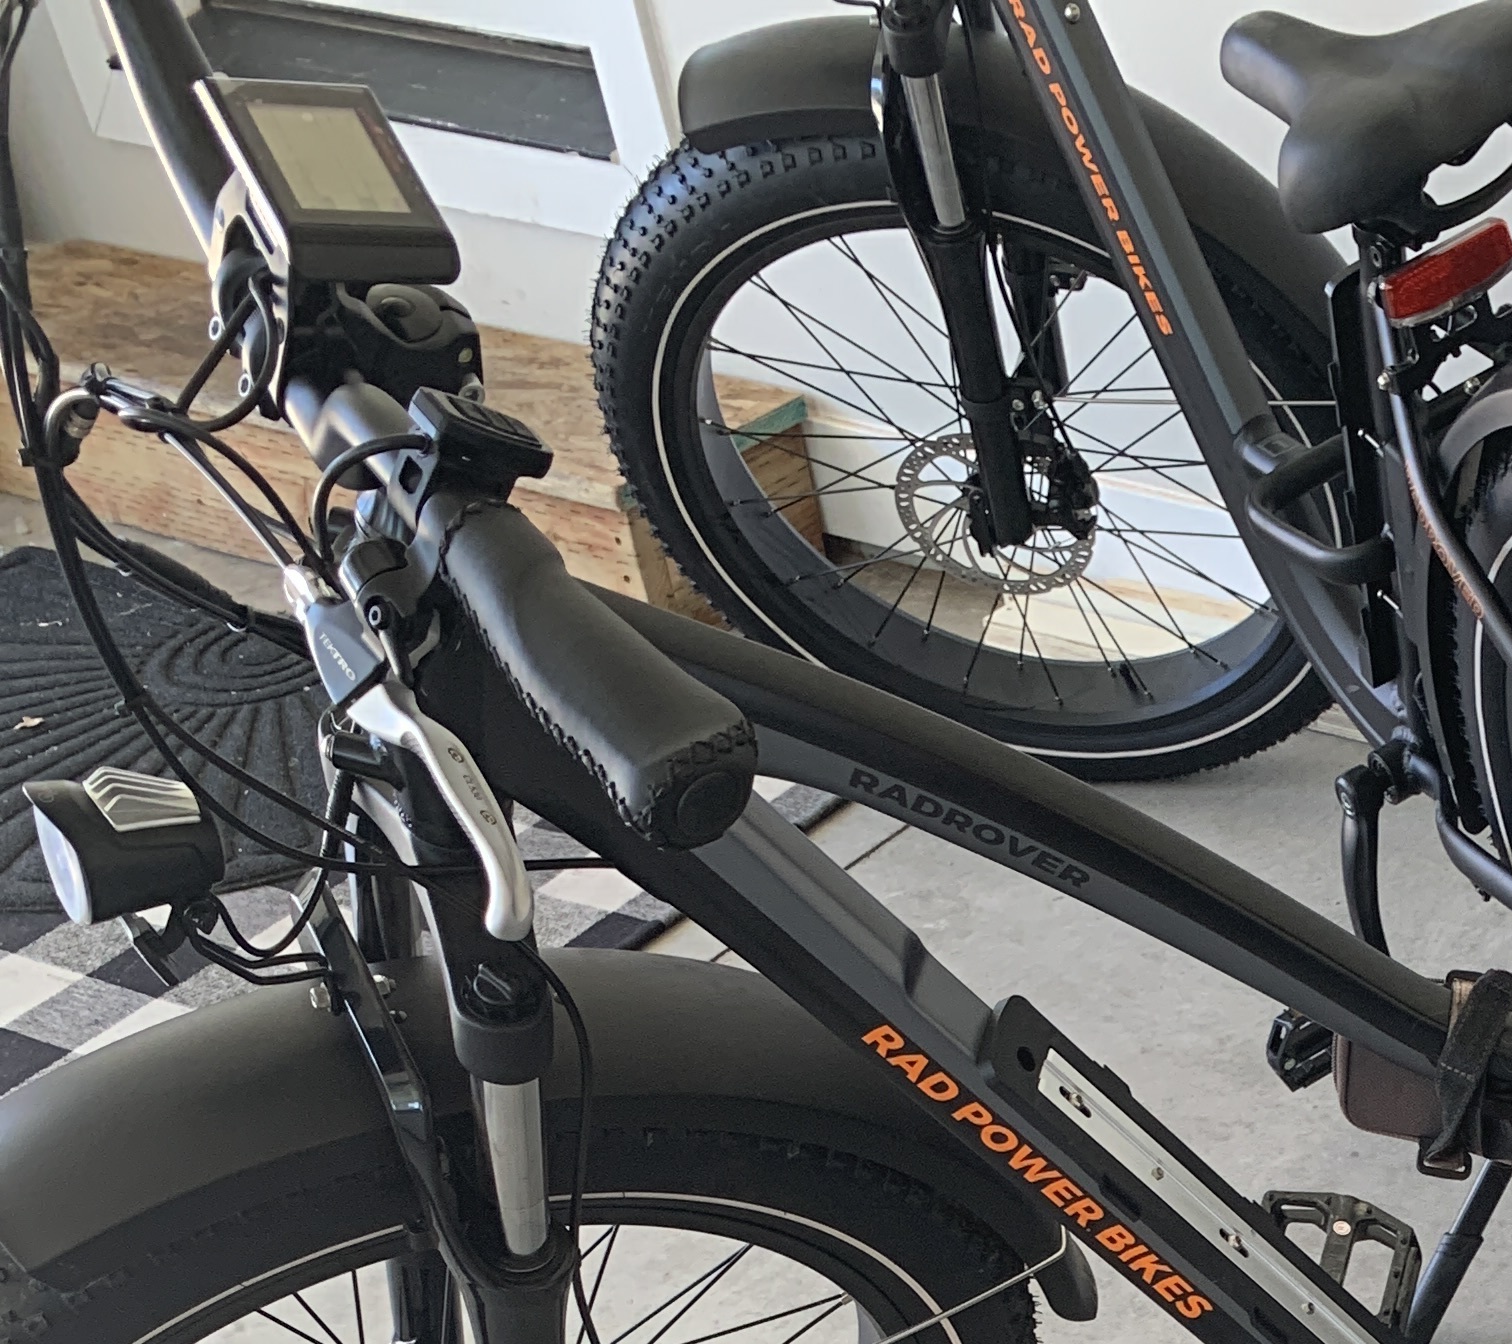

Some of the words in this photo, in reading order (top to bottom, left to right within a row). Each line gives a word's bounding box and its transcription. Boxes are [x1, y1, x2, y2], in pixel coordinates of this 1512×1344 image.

[1008, 0, 1052, 75] RAD
[1048, 82, 1119, 222] POWER
[1116, 228, 1173, 338] BIKES
[319, 631, 357, 683] TEKTRO
[848, 767, 1091, 889] RADROVER
[861, 1024, 960, 1103] RAD
[952, 1100, 1105, 1228] POWER
[1094, 1224, 1214, 1321] BIKES
